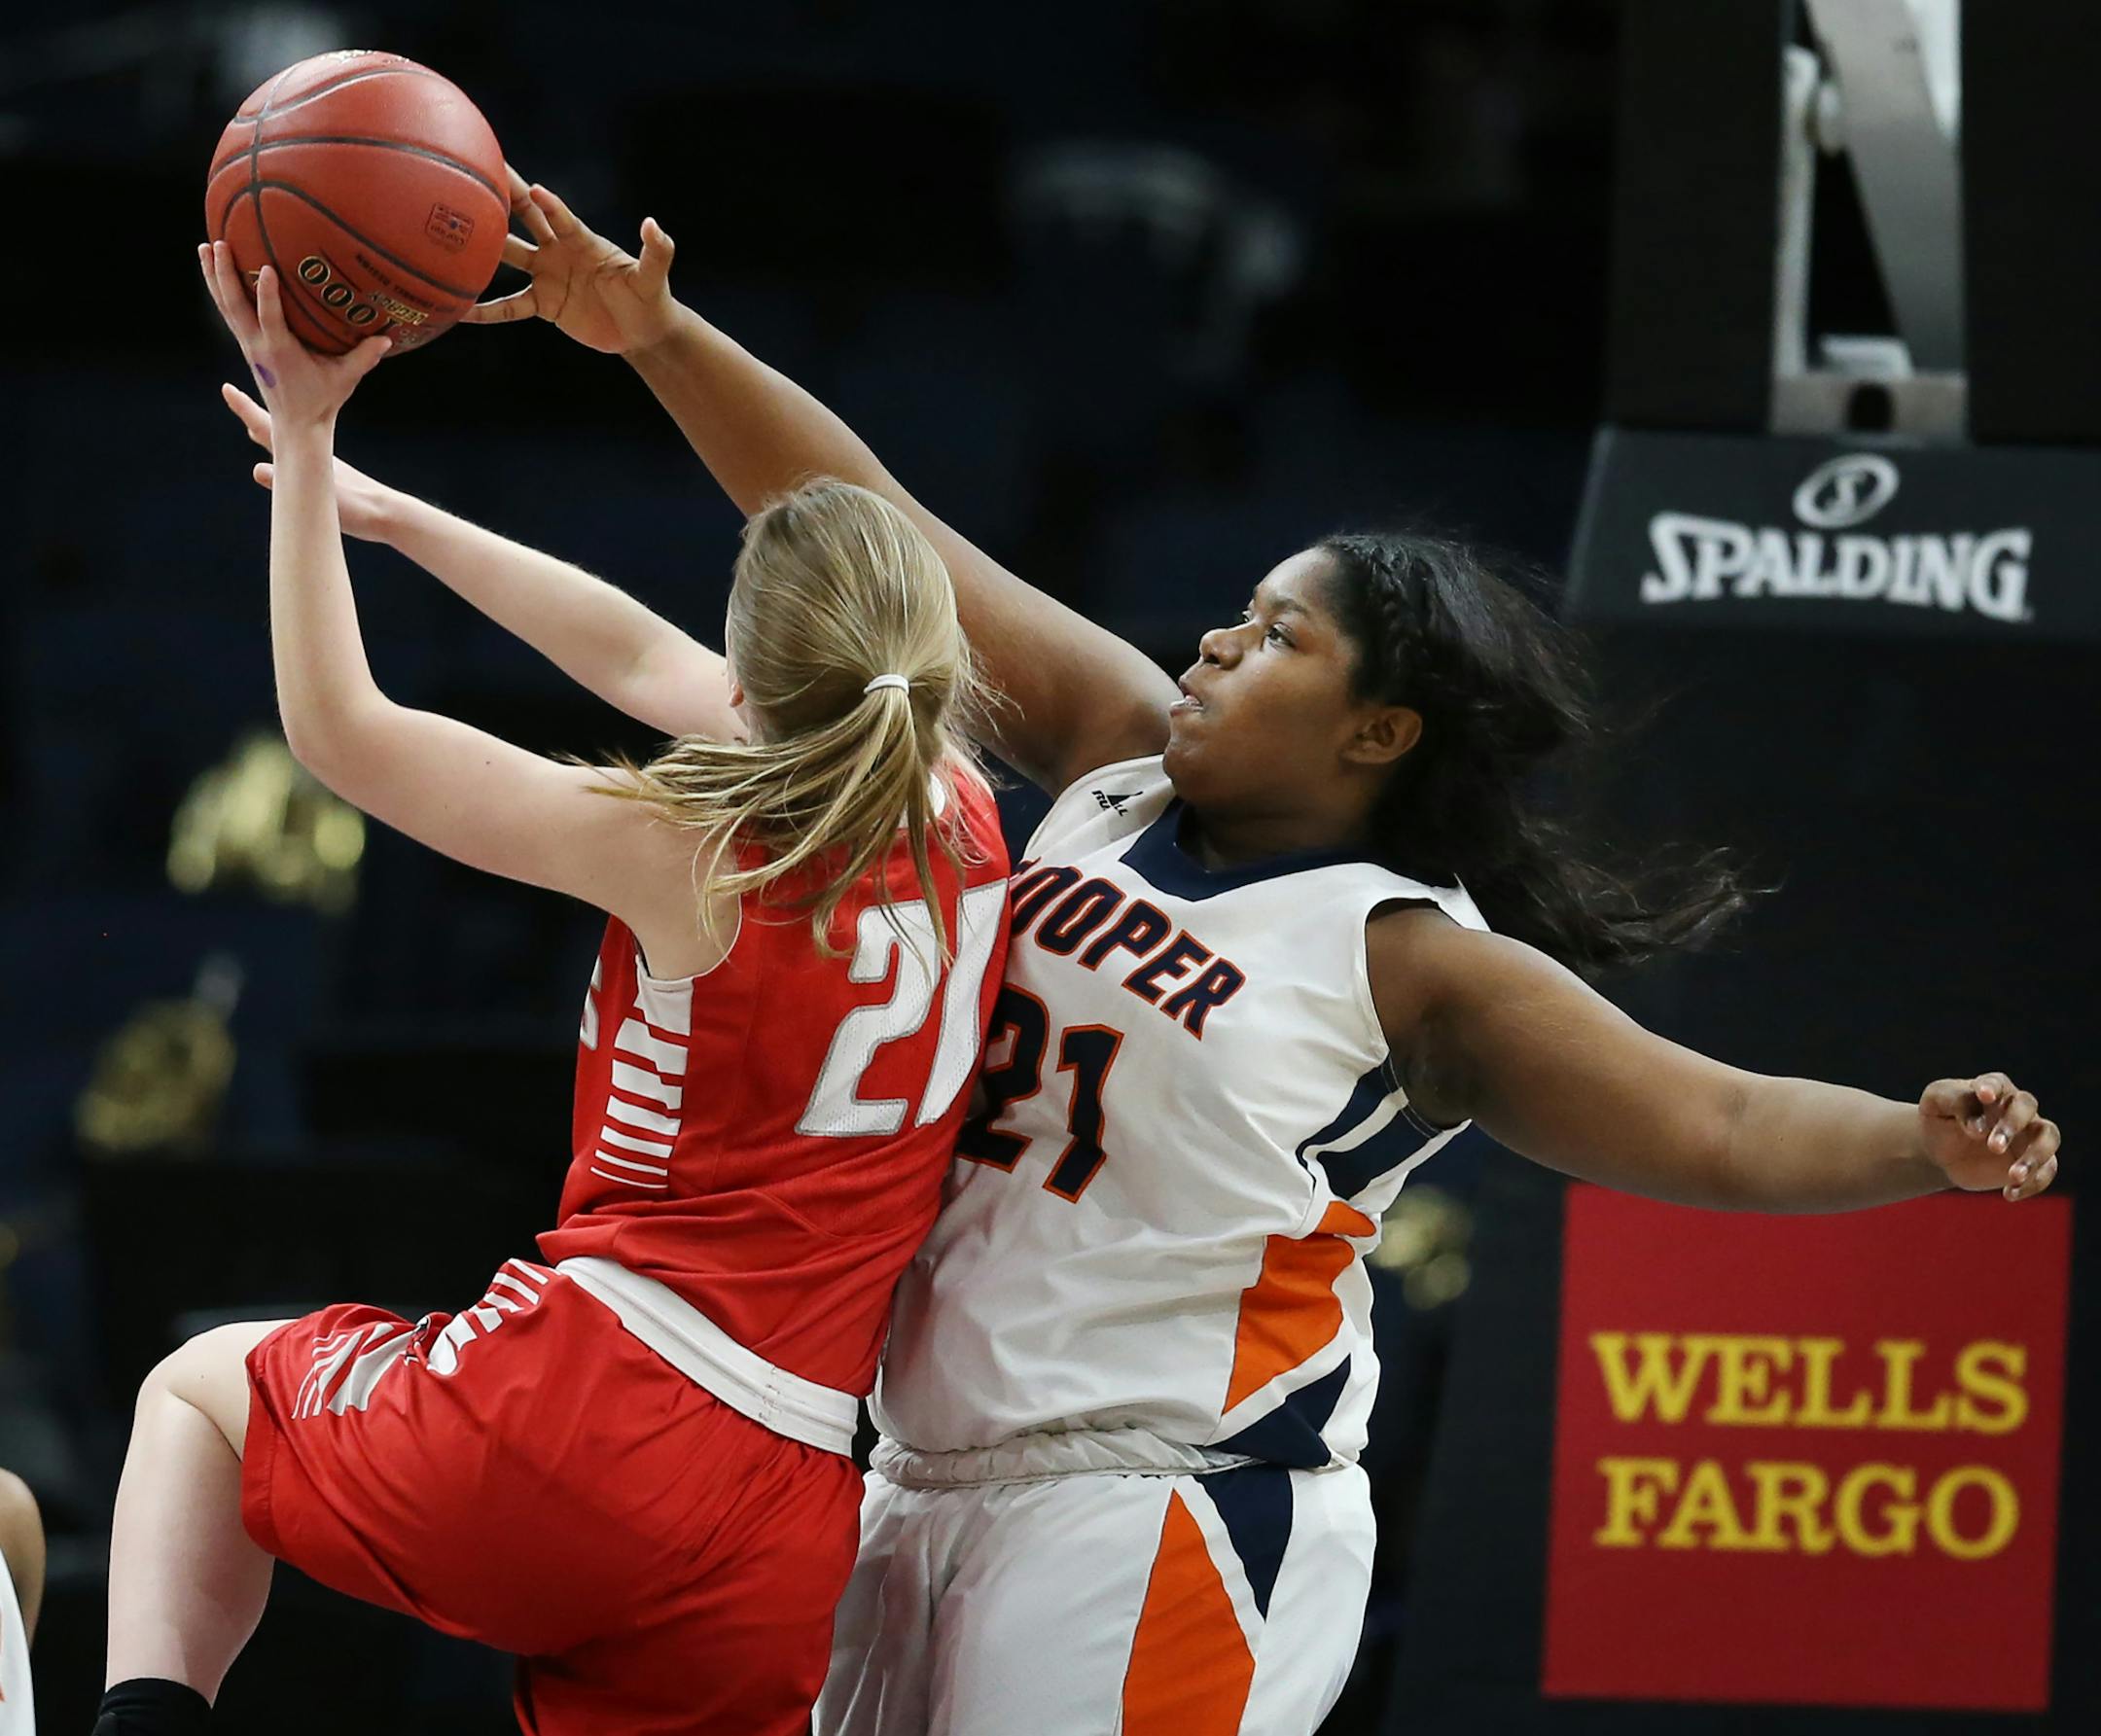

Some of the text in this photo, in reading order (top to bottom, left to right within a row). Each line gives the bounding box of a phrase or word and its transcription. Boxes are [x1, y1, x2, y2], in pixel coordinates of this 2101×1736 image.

[1640, 511, 2032, 622] SPALDING
[796, 877, 1009, 1137] 21
[955, 982, 1124, 1204] 21
[1589, 1331, 2029, 1435] WELLS
[1593, 1457, 2020, 1560] FARGO
